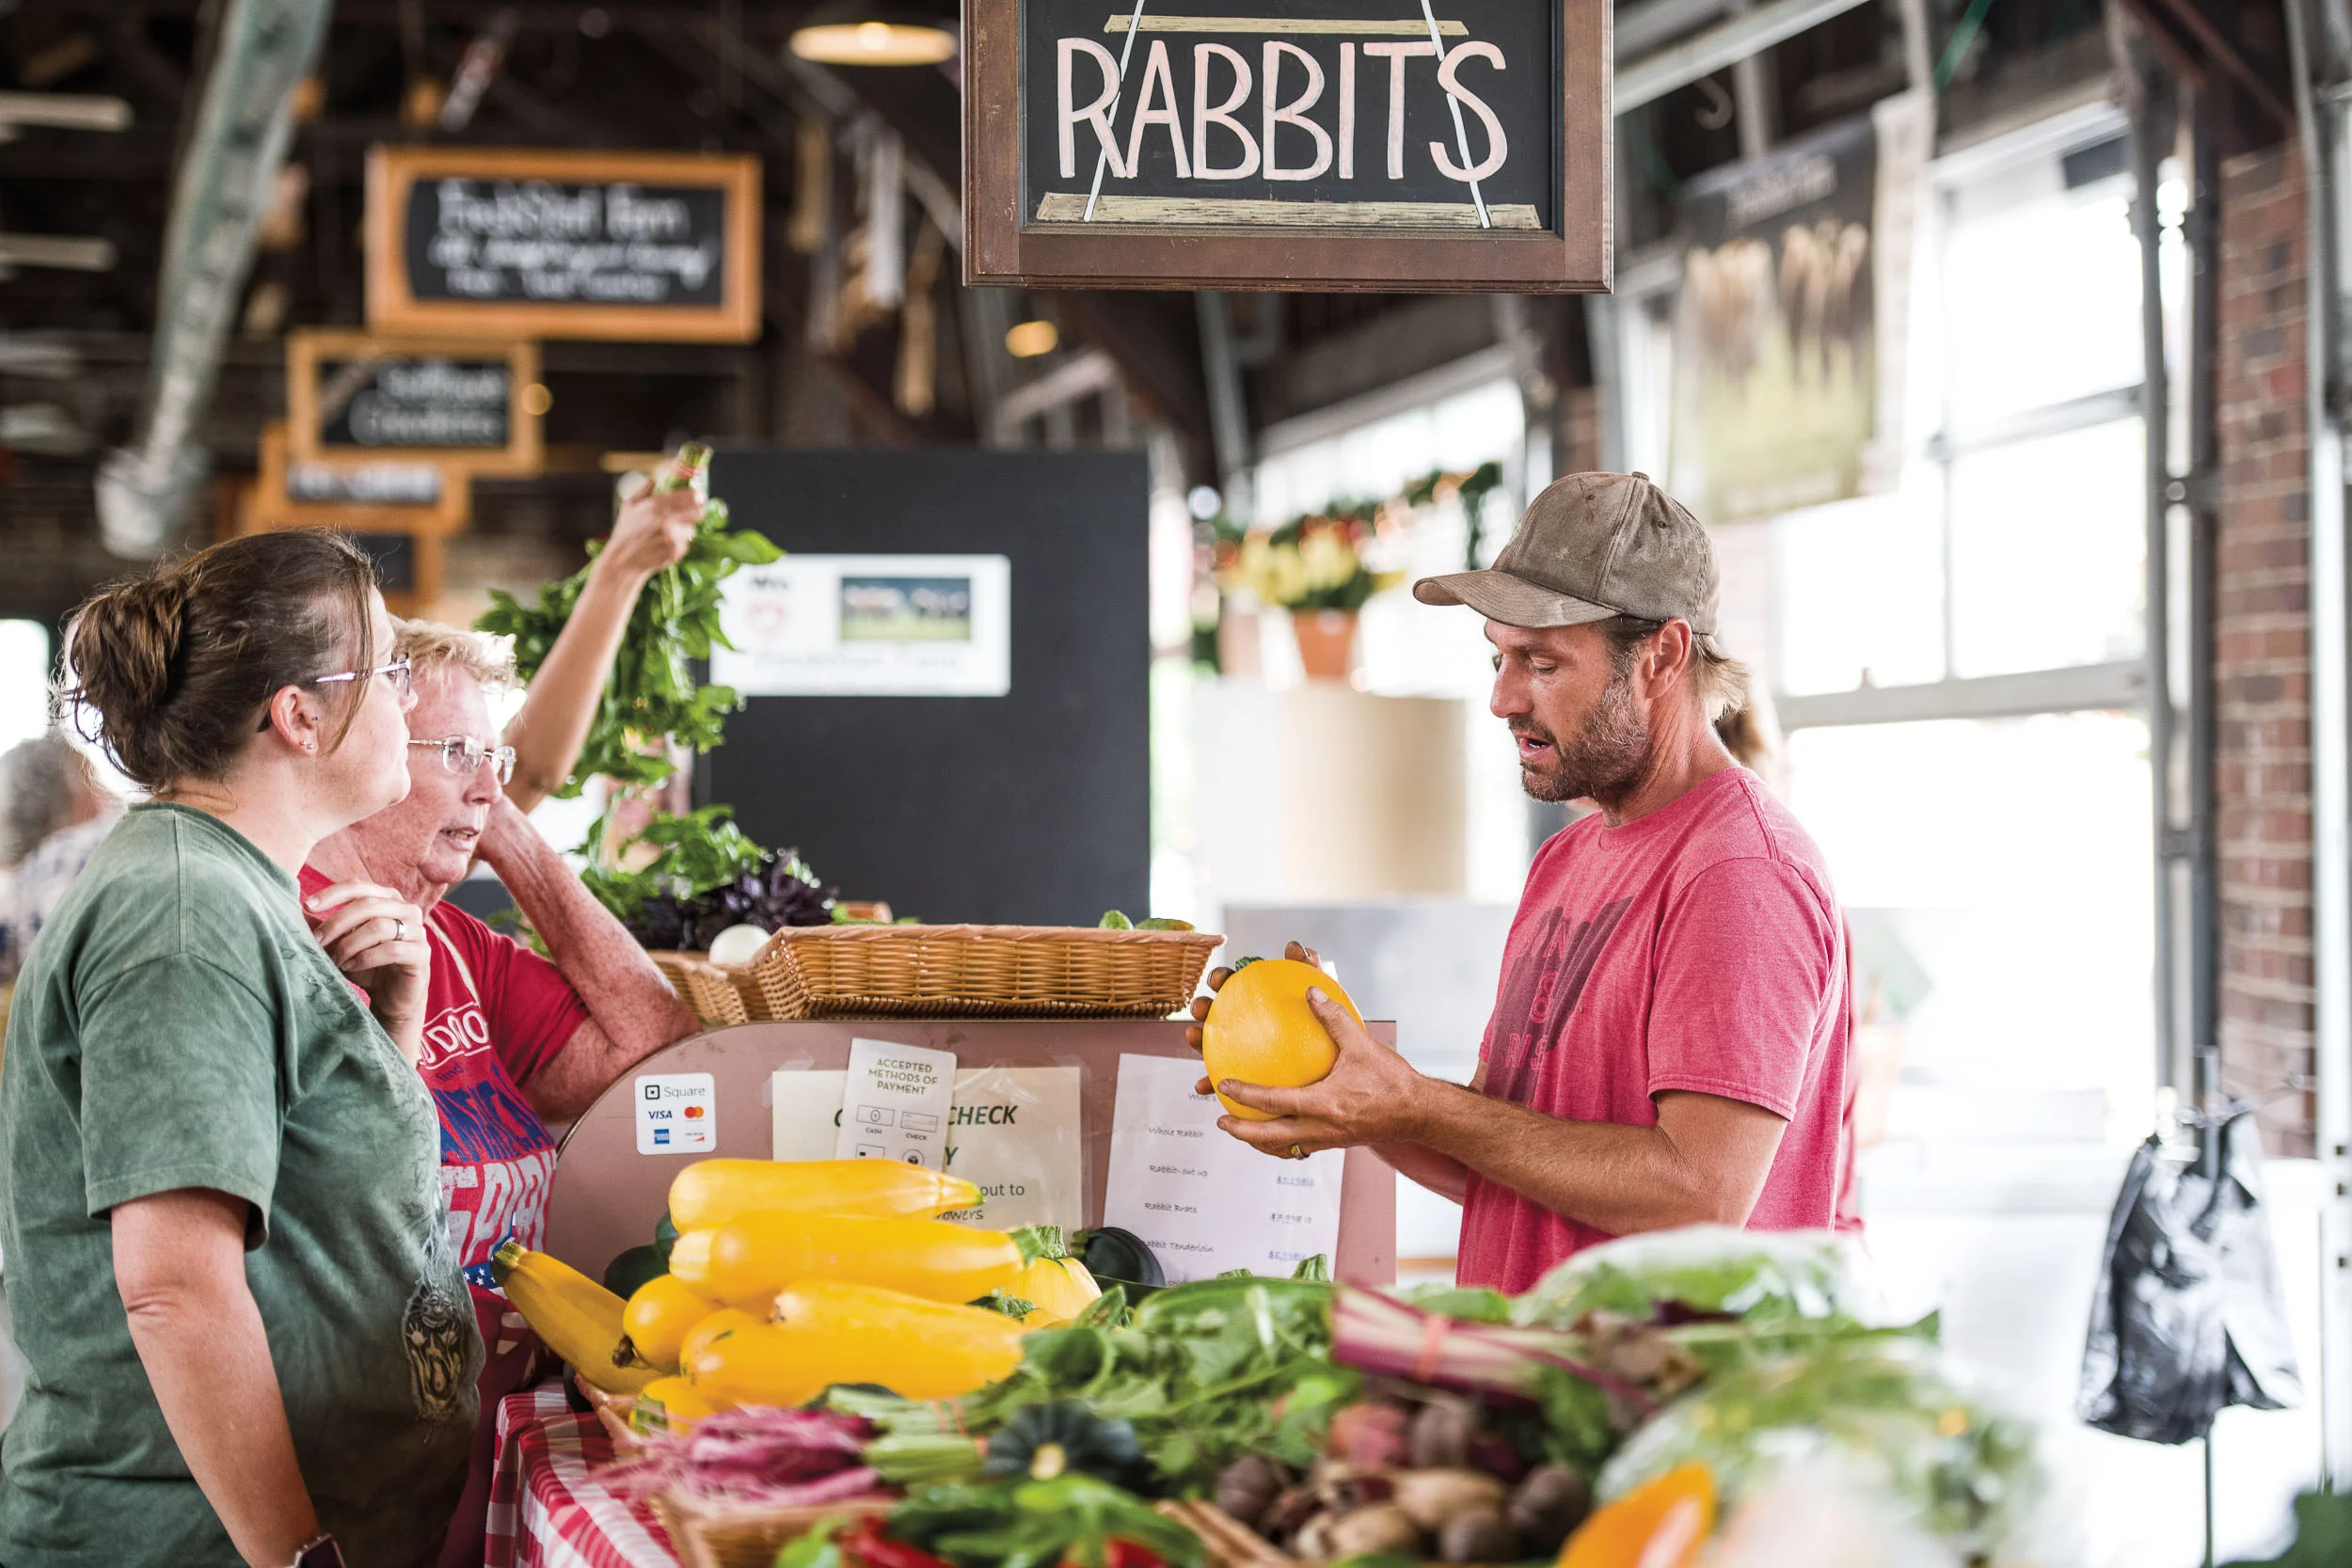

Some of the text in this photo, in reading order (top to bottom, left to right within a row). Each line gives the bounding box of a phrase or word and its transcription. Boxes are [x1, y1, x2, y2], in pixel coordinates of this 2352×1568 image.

[1057, 38, 1508, 182] RABBITS
[877, 1058, 932, 1073] ACCEPTED
[867, 1069, 938, 1085] METHODS OF
[663, 1086, 706, 1099] Square
[877, 1081, 927, 1095] PAYMENT
[647, 1110, 673, 1119] VISA
[948, 1105, 1019, 1126] CHECK
[905, 1132, 928, 1141] CHECK
[1009, 1184, 1025, 1196] to
[1144, 1203, 1171, 1212] Rabbit
